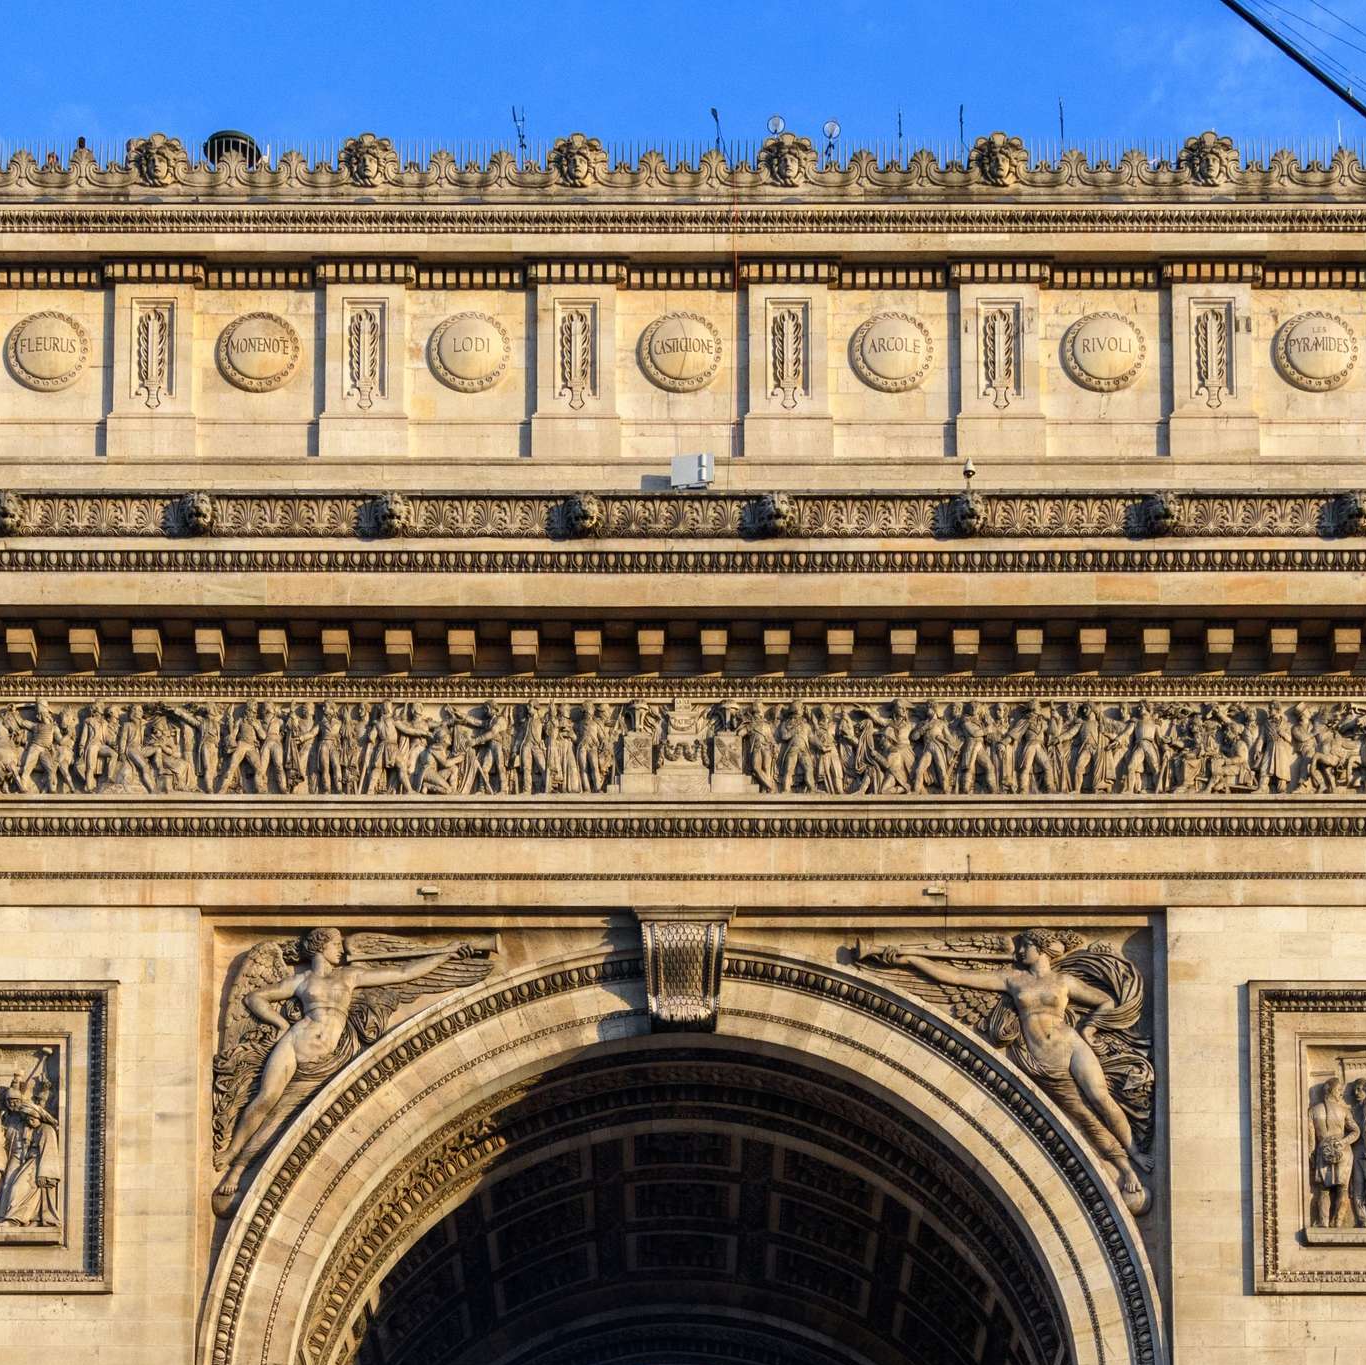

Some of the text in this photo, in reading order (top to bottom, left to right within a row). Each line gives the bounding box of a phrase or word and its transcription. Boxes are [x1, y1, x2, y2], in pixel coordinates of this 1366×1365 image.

[19, 336, 77, 354] FLEURUS
[453, 336, 490, 353] LODI
[868, 336, 921, 354] ARCOLE
[1082, 336, 1132, 354] RIVOLI
[1289, 336, 1350, 354] PYRAMIDES
